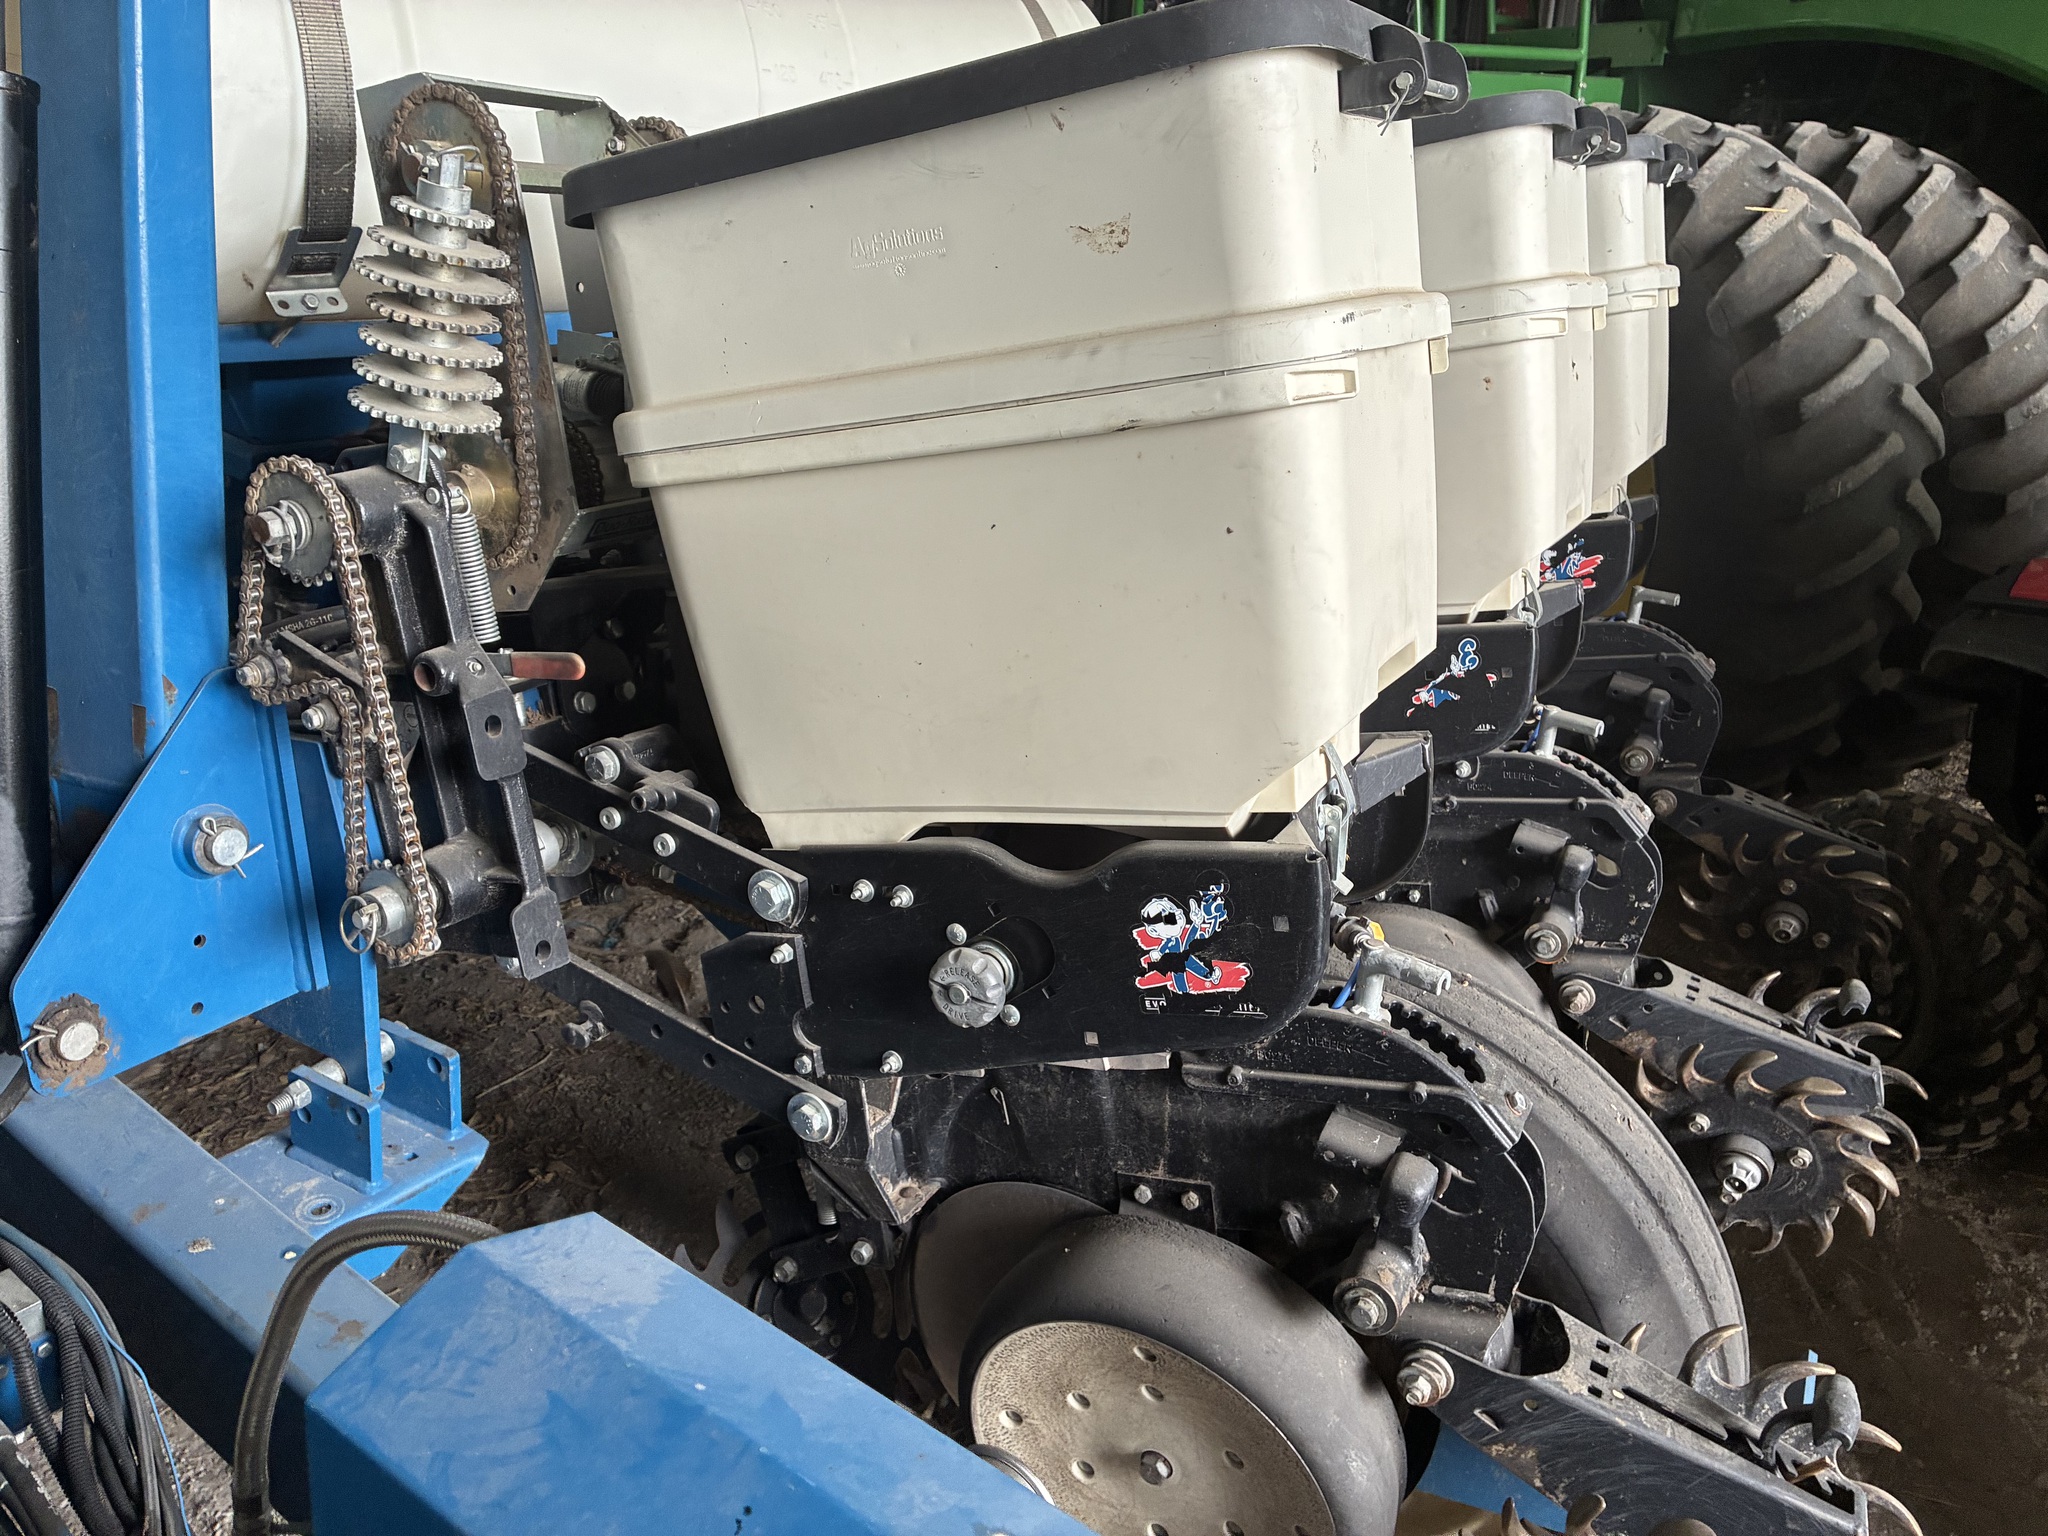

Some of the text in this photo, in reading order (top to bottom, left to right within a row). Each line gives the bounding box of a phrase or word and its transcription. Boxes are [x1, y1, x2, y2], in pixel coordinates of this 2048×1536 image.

[850, 226, 944, 259] AgSolutions
[944, 967, 981, 988] RELEASE
[942, 1003, 970, 1021] DRIVE
[1306, 1035, 1352, 1053] DEEPER
